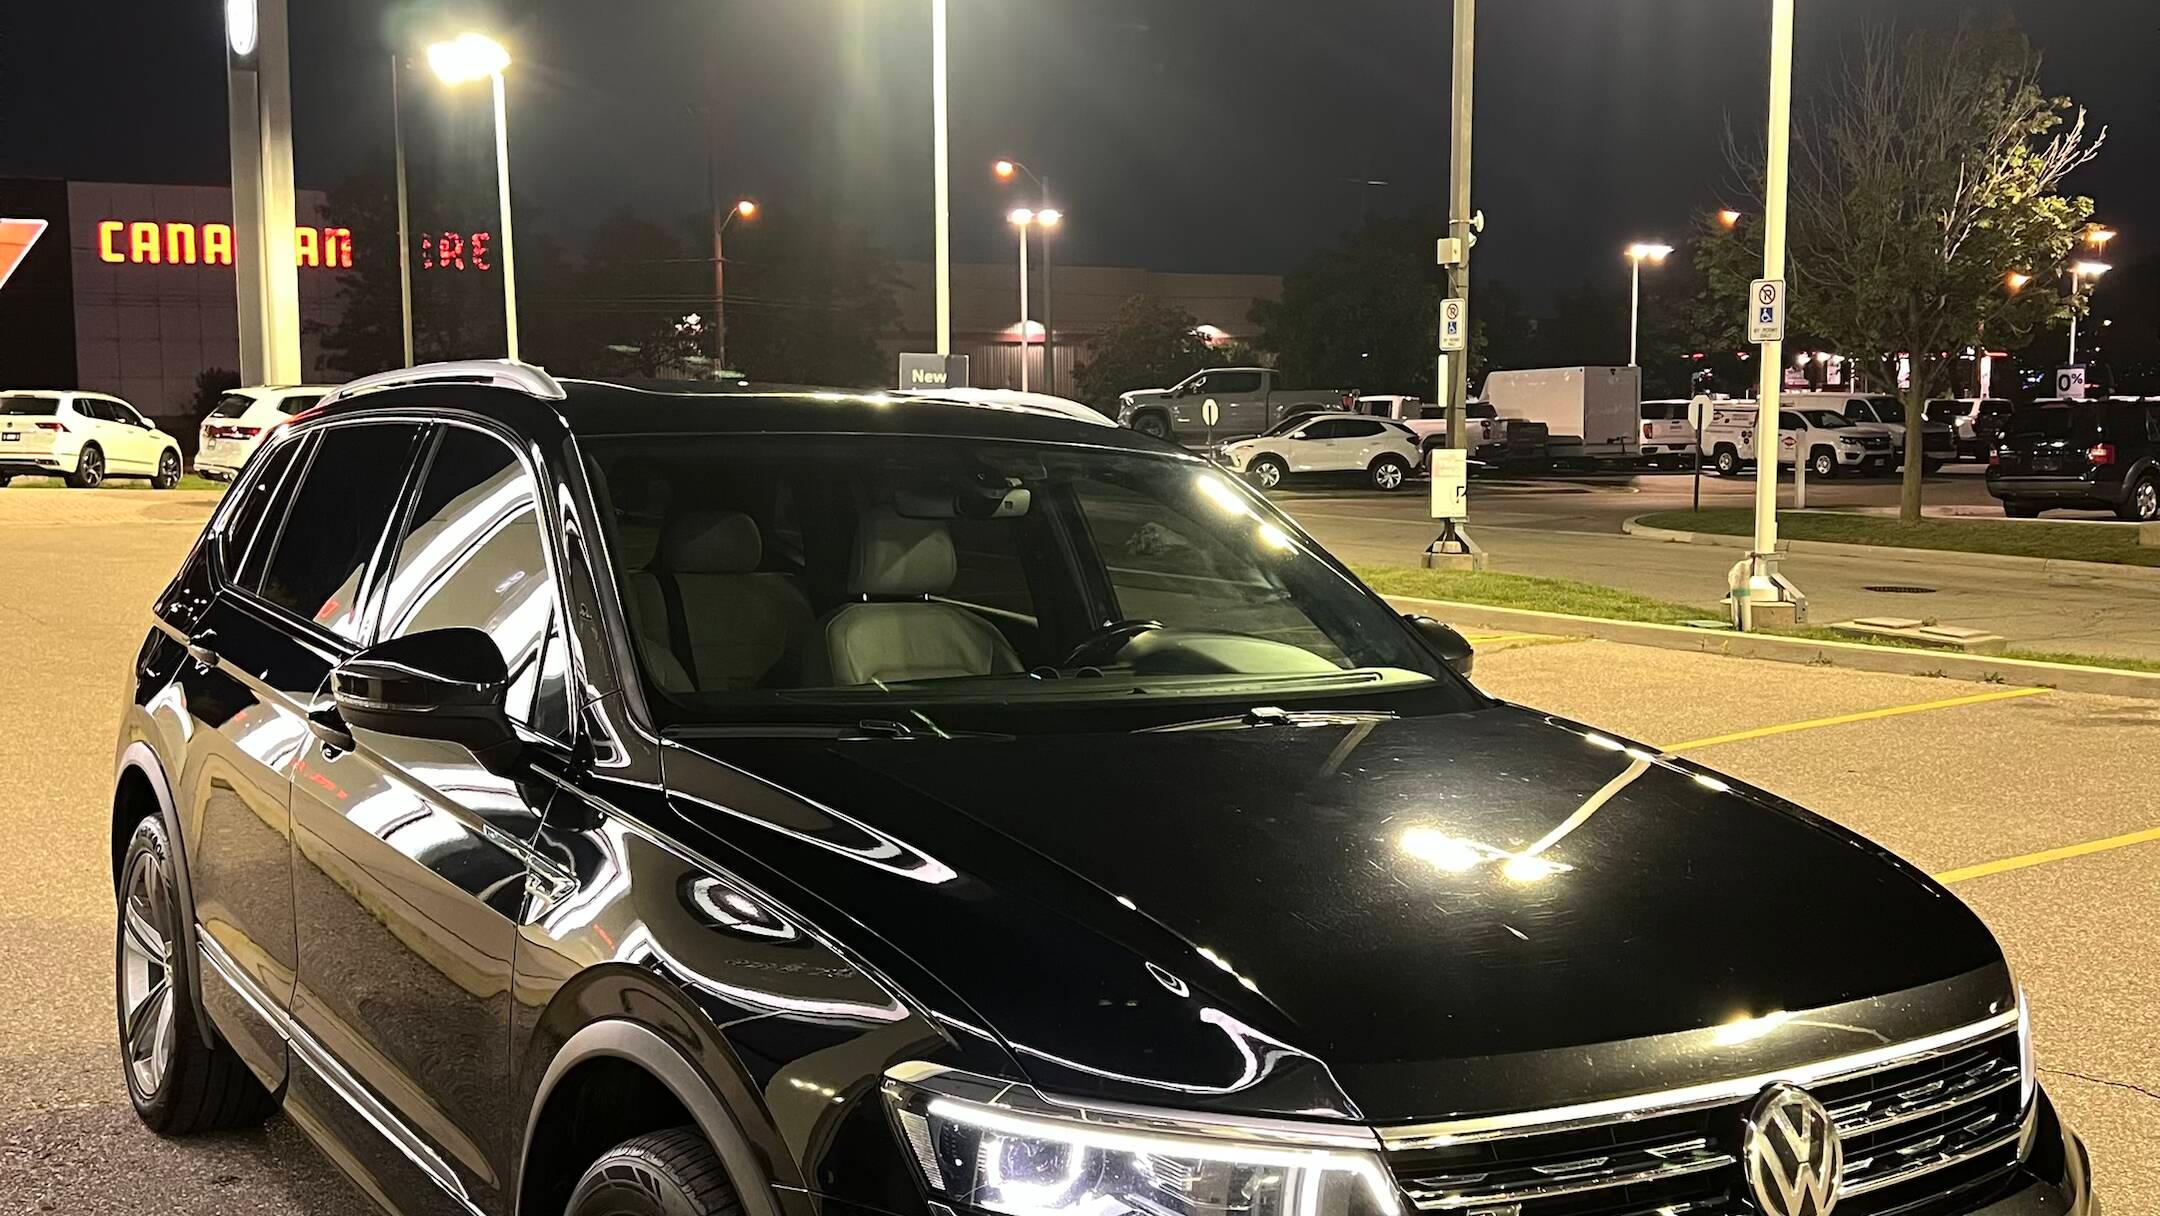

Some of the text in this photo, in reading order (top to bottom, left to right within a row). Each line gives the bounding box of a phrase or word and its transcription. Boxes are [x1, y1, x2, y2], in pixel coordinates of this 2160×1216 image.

[97, 220, 491, 271] CANAAN IRE
[912, 369, 947, 383] New
[2058, 373, 2083, 392] 0%
